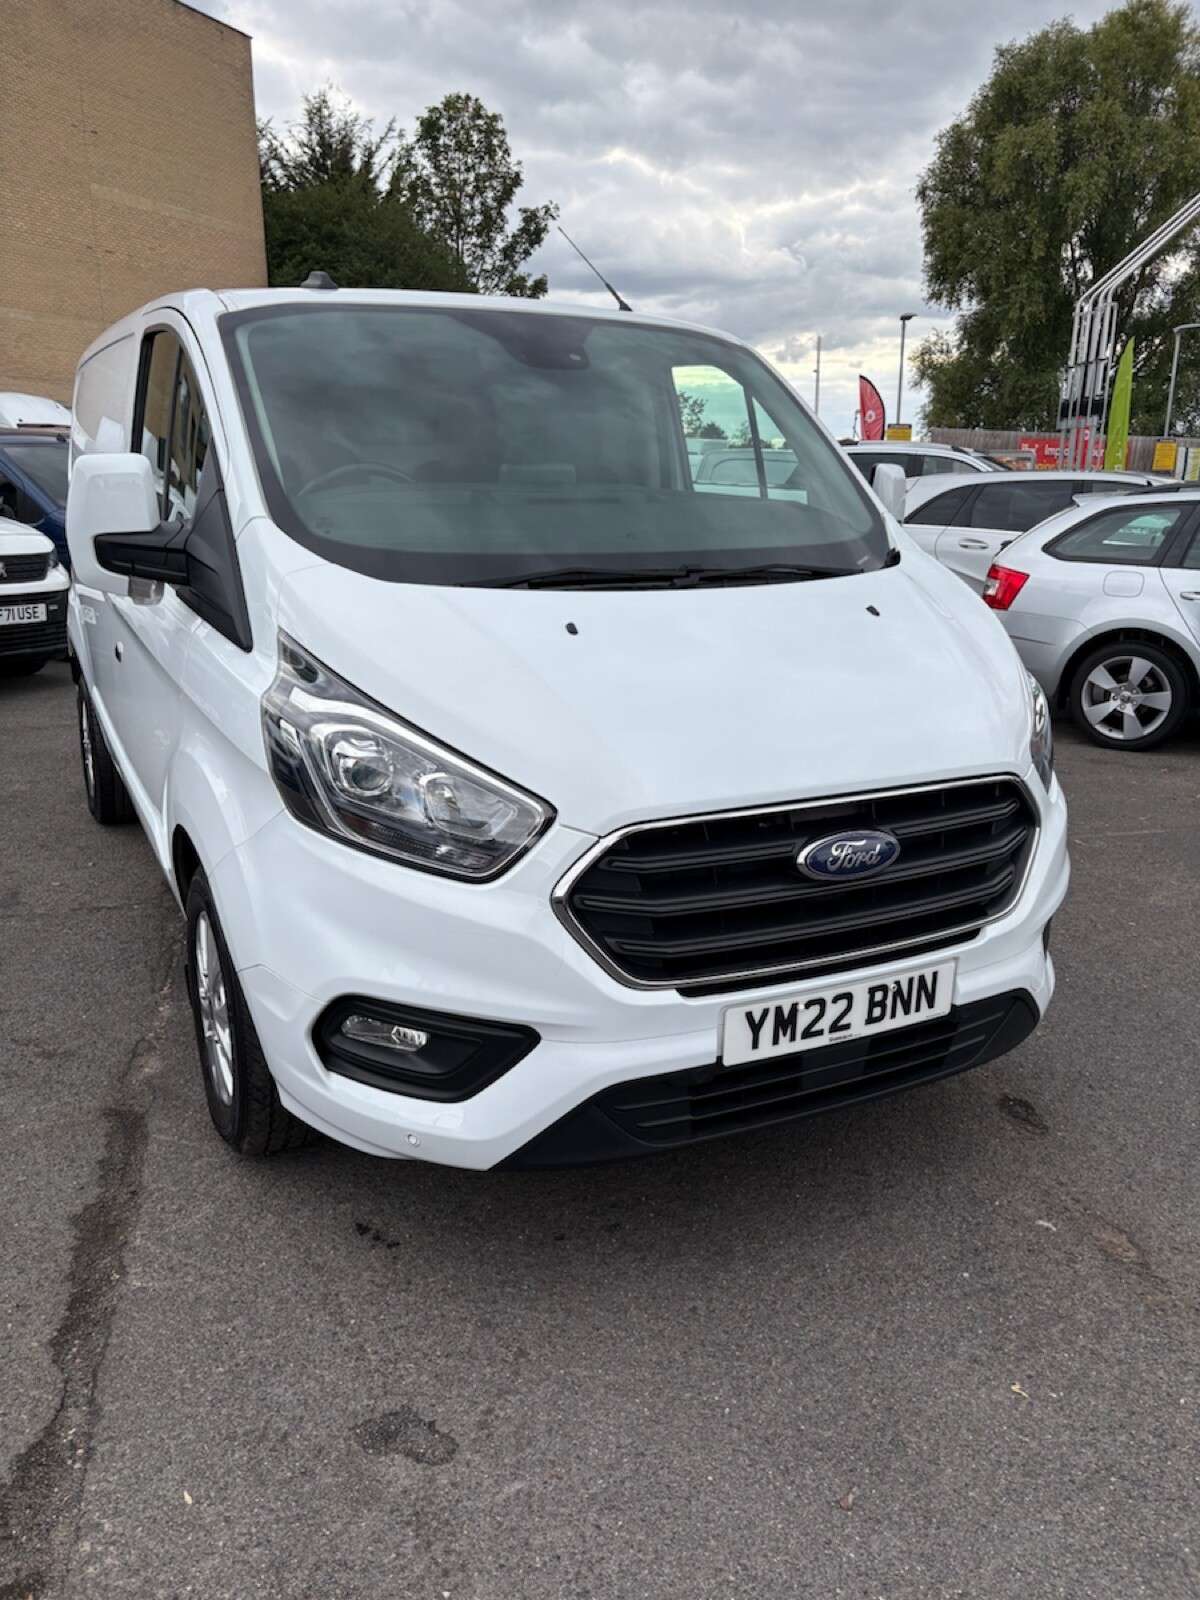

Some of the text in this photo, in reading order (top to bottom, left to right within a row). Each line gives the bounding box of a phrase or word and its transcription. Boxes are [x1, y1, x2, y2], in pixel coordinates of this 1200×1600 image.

[17, 605, 40, 621] USE
[826, 839, 881, 872] Ford
[745, 971, 938, 1050] YM22 BNN
